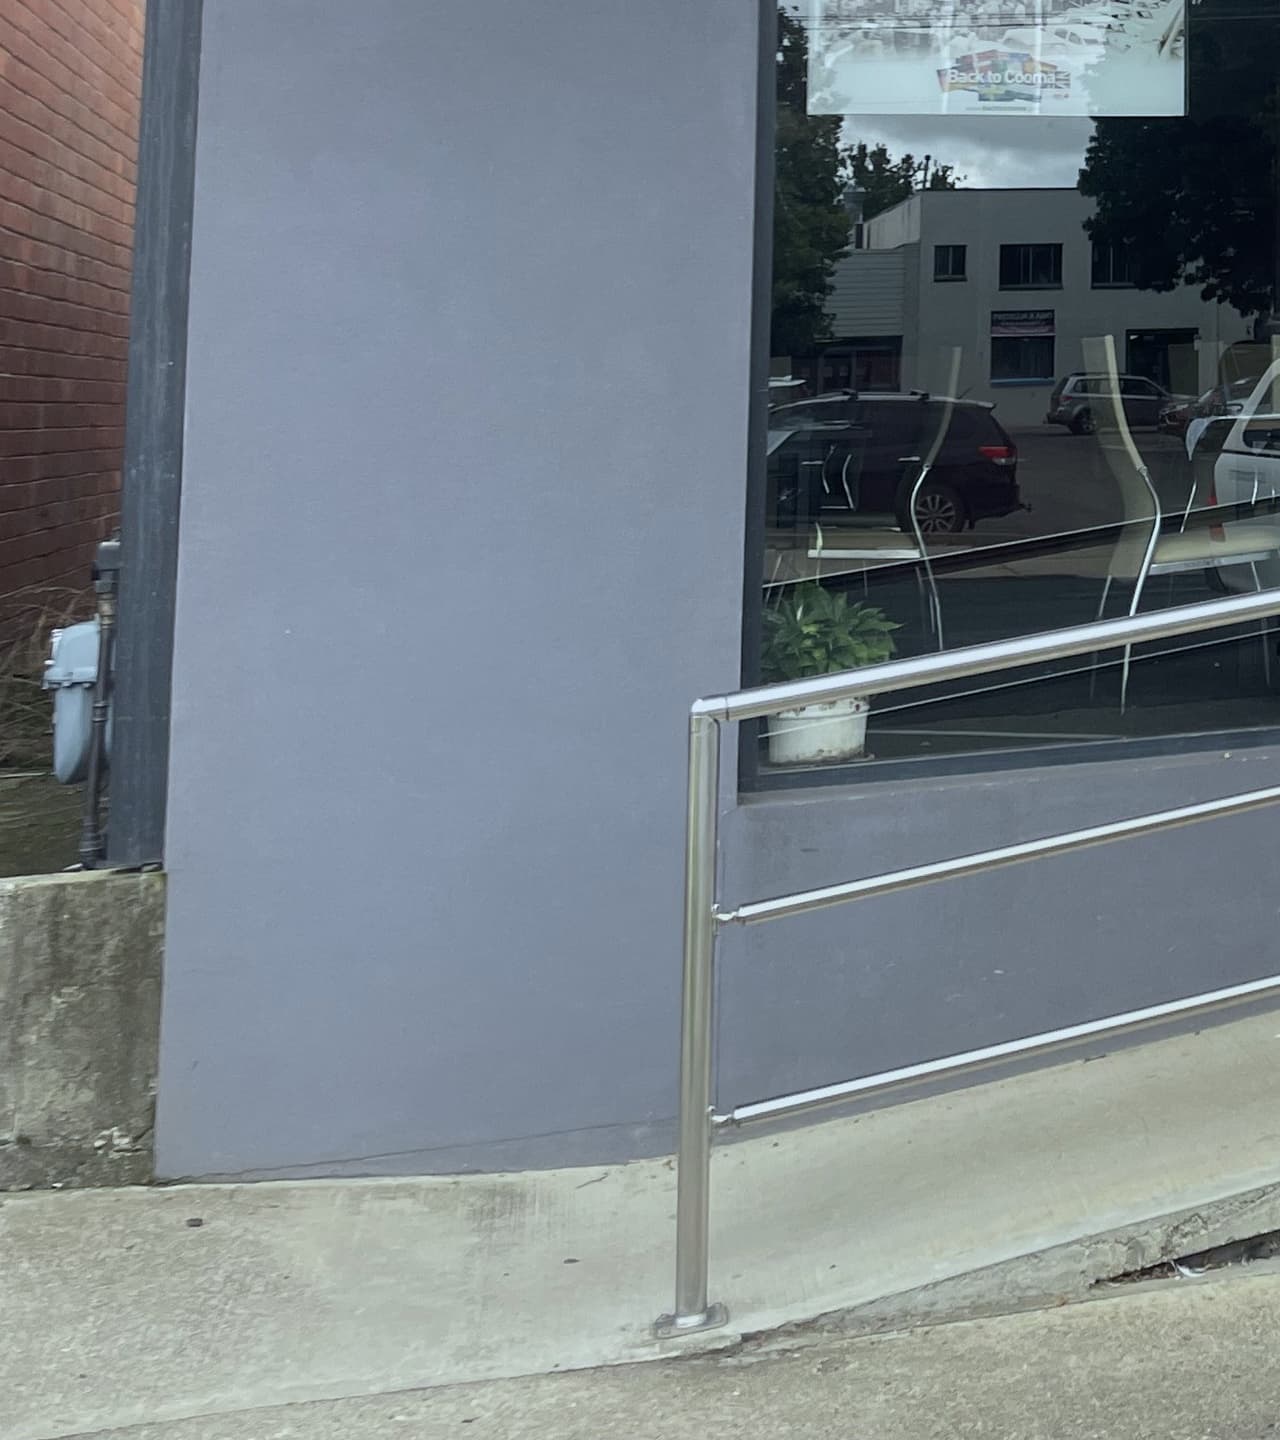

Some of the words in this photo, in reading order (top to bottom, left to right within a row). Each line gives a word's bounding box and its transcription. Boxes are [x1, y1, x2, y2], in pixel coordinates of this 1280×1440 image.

[948, 69, 984, 83] Back
[989, 71, 1002, 84] to
[1004, 70, 1056, 84] Cooma
